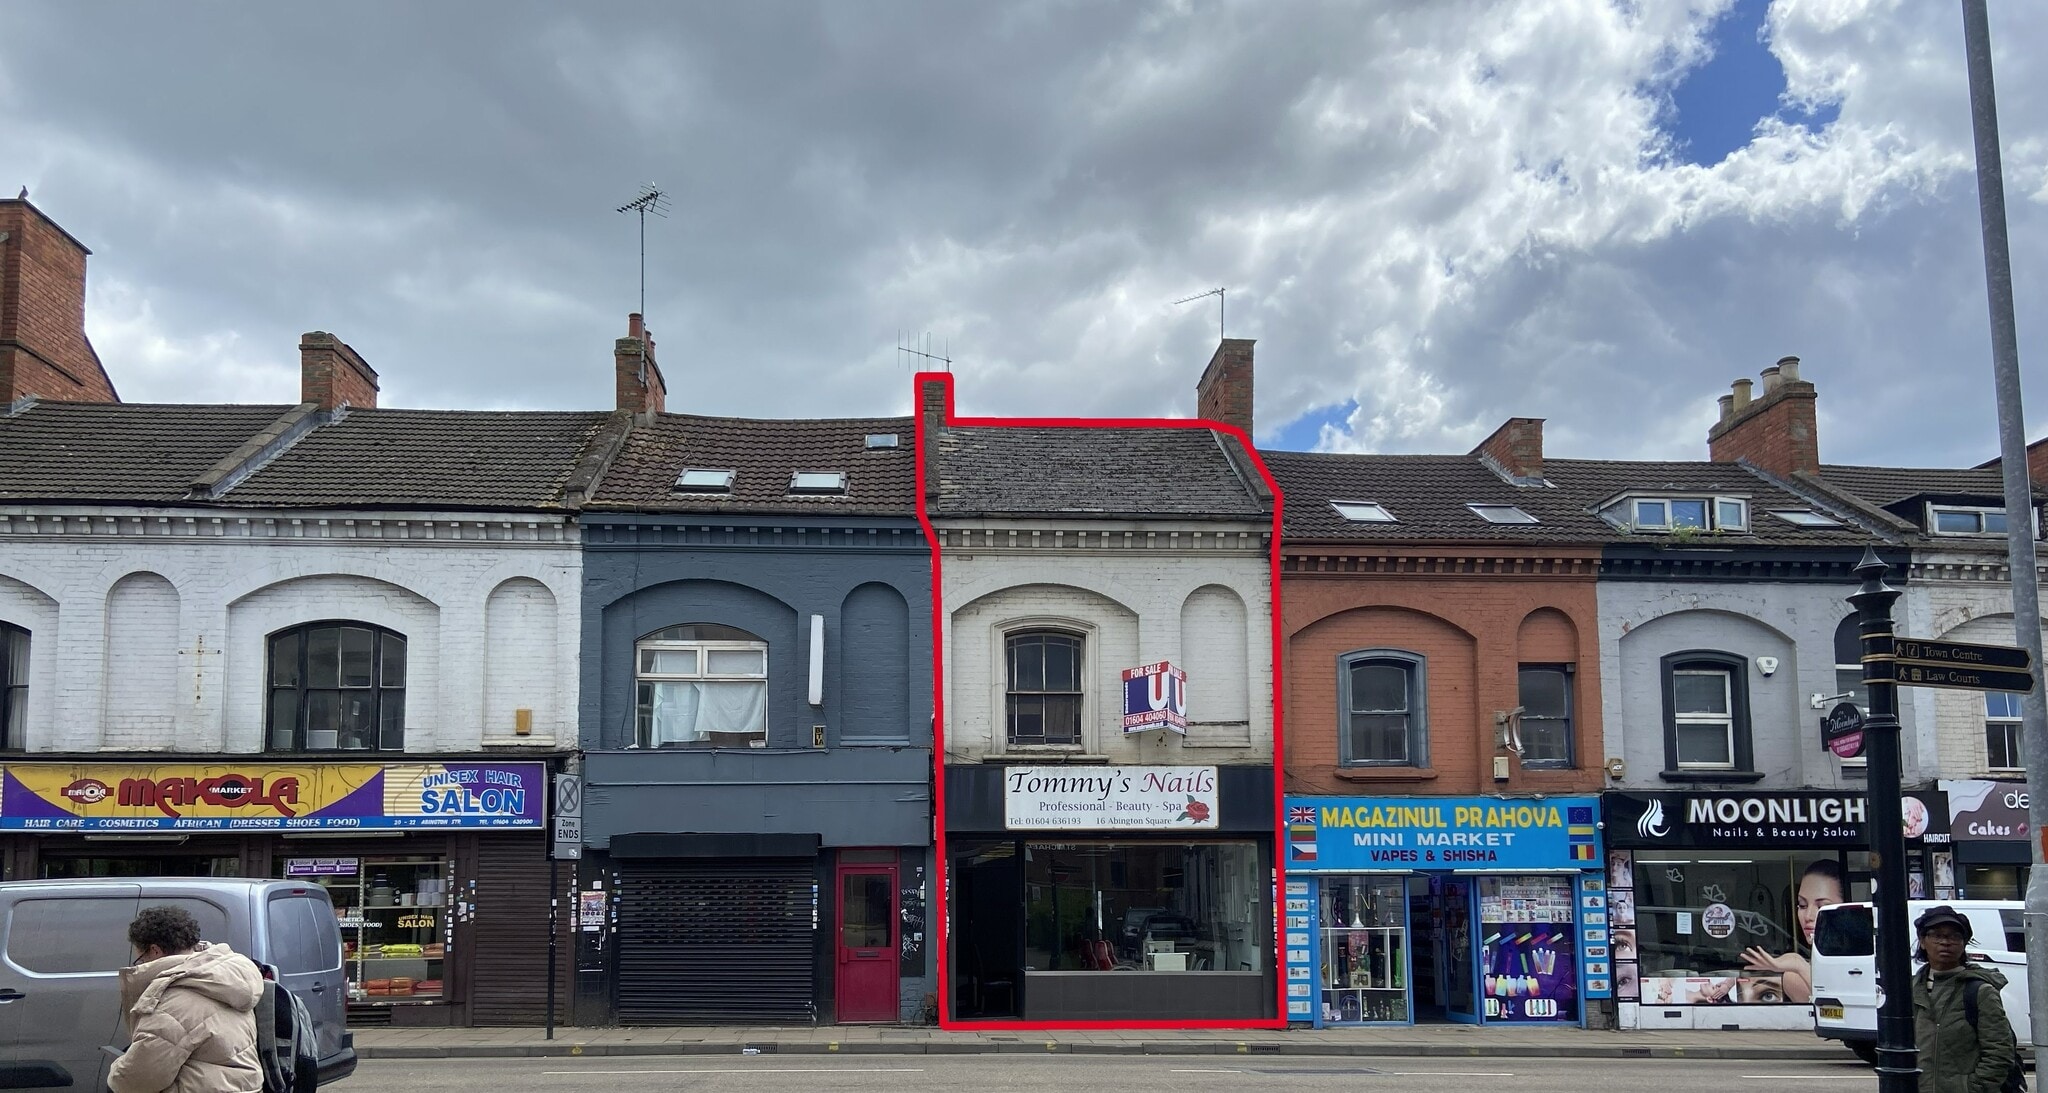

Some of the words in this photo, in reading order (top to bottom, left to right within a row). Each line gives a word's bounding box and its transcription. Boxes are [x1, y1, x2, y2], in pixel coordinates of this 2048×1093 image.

[1923, 647, 1948, 658] Town
[1952, 648, 1983, 661] Centre
[1130, 667, 1144, 679] FOR
[1144, 664, 1162, 676] SALE
[1926, 670, 1945, 681] Law
[1948, 672, 1981, 685] Courts
[423, 769, 478, 788] UNISEX
[485, 770, 523, 788] HAIR
[1009, 769, 1131, 801] Tommy's
[1140, 769, 1214, 793] Nails
[210, 786, 253, 794] MARKET
[421, 788, 525, 814] SALON
[1039, 801, 1106, 811] Professional
[1116, 801, 1152, 813] Beauty
[1162, 801, 1182, 813] Spa
[1321, 806, 1447, 828] MAGAZINUL
[1455, 806, 1562, 828] PRAHOVA
[1689, 797, 1868, 824] MOONLIGH
[24, 819, 50, 828] HAIR
[56, 819, 85, 828] CARE
[99, 818, 159, 828] COSMETICS
[173, 818, 222, 828] AFRICAN
[229, 818, 280, 828] (DRESSES
[286, 818, 322, 827] SHOES
[327, 818, 361, 828] FOOD)
[561, 819, 575, 828] Zone
[1009, 817, 1024, 825] Tel:
[1109, 817, 1144, 827] Abington
[1145, 818, 1172, 826] Square
[558, 829, 579, 839] ENDS
[1713, 827, 1749, 837] Nails
[1756, 827, 1764, 837] &
[1772, 827, 1818, 839] Beauty
[1823, 827, 1857, 837] Salon
[1968, 820, 2011, 836] Cakes
[1353, 832, 1403, 846] MINI
[1417, 832, 1516, 846] MARKET
[1923, 833, 1951, 843] HAIRCUT
[1371, 849, 1418, 862] VAPES
[1425, 849, 1435, 861] &
[1443, 849, 1498, 861] SHISHA
[397, 919, 434, 928] SALON
